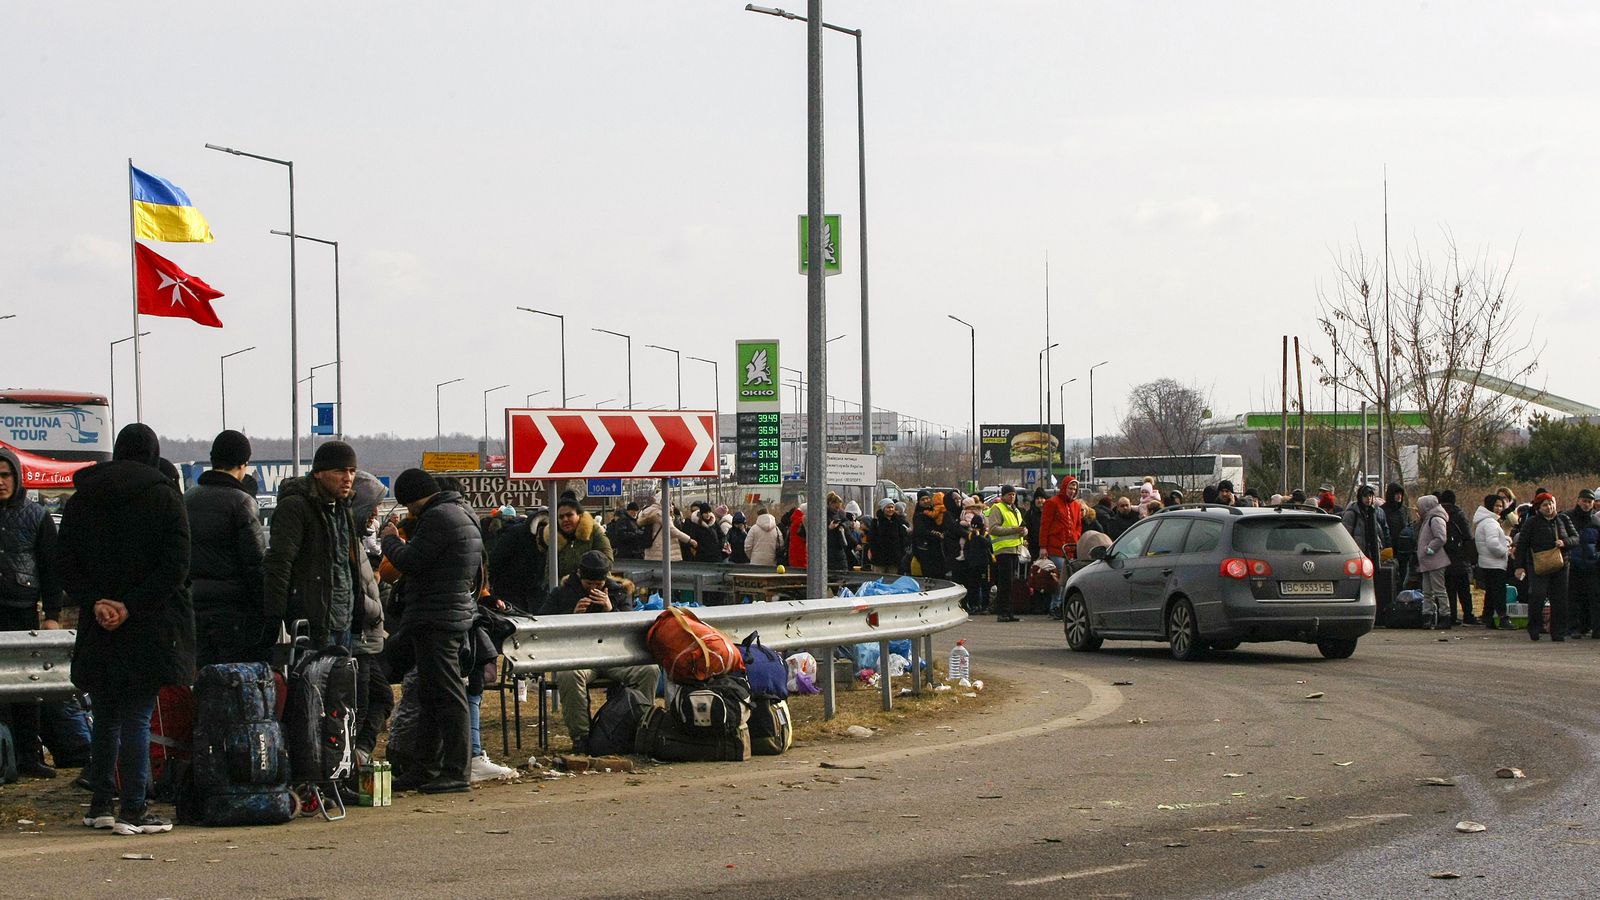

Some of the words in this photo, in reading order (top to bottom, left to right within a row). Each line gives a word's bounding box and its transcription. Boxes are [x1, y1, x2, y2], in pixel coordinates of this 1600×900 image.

[10, 429, 47, 441] TOUR
[983, 429, 1010, 437] БУРГЕР
[1300, 583, 1318, 592] 9553
